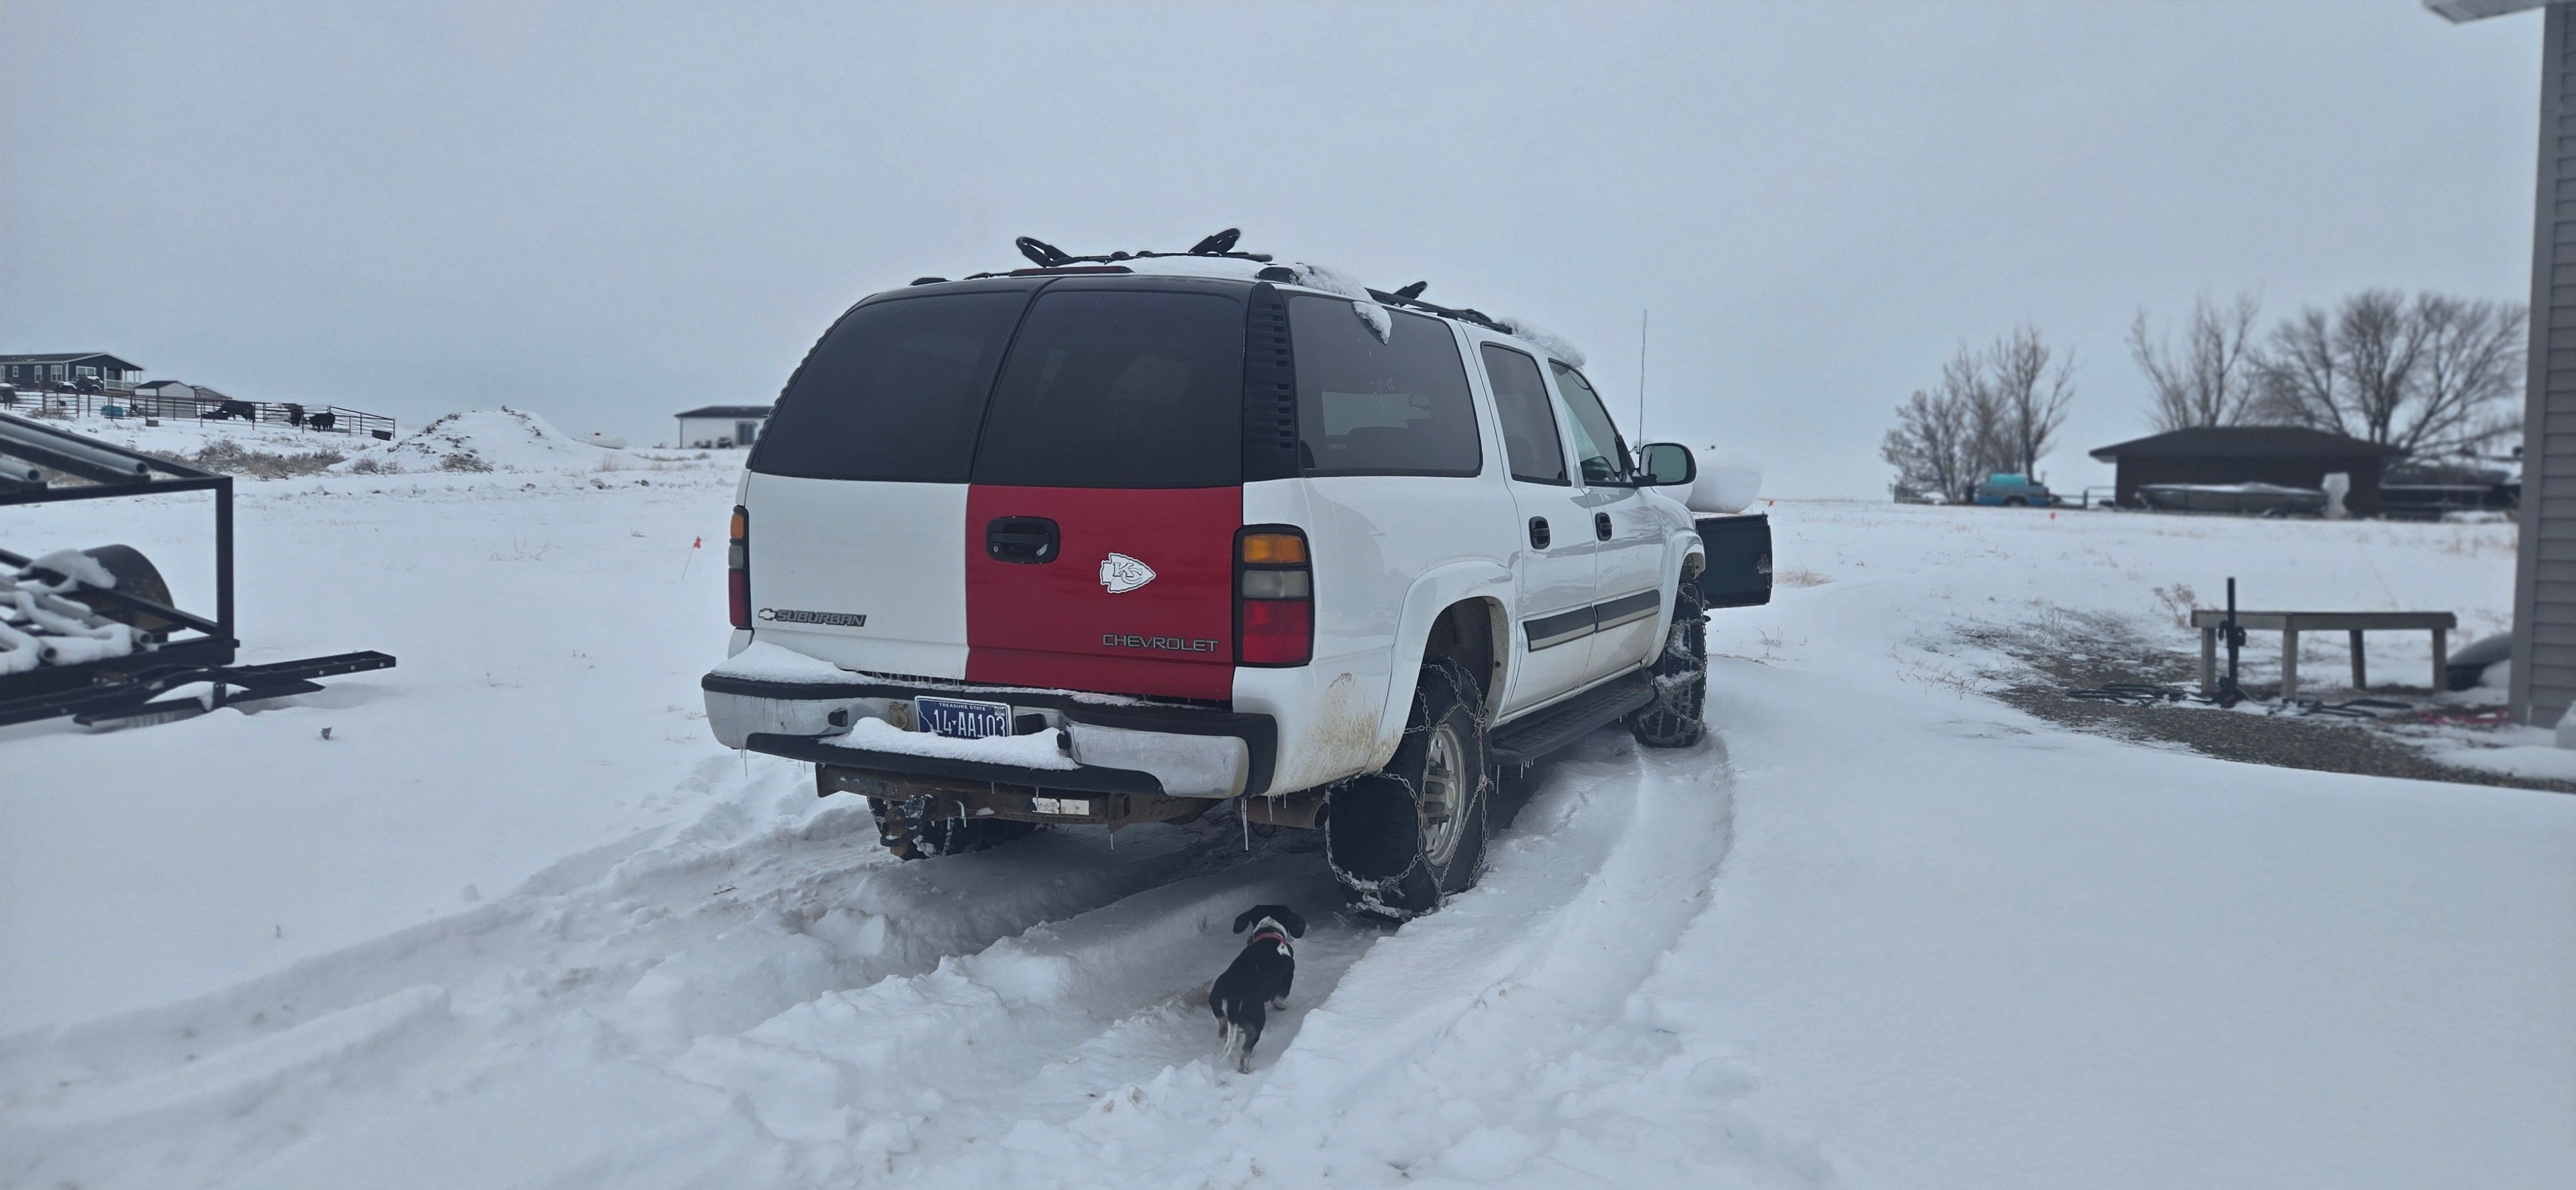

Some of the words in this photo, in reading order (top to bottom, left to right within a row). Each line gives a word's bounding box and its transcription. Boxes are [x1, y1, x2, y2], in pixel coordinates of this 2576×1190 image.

[1113, 562, 1142, 585] KC
[777, 610, 866, 627] SUBURBAN
[1103, 634, 1218, 652] CHEVROLET
